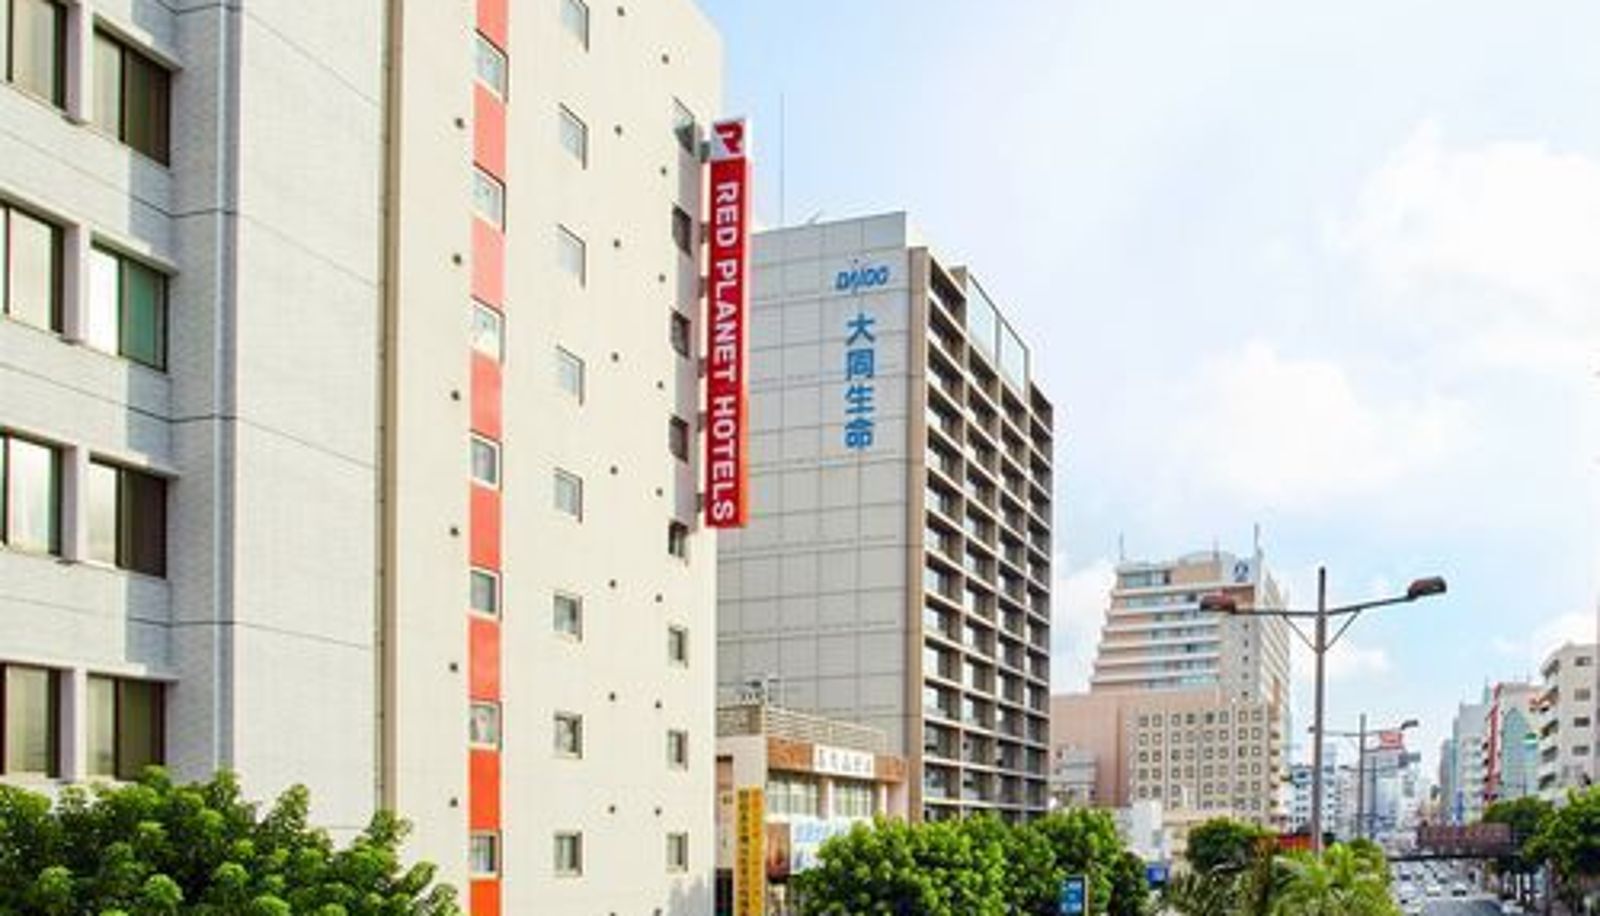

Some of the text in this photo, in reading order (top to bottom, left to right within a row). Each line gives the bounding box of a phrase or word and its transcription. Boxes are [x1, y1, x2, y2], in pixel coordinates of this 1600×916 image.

[711, 181, 739, 521] RED PLANET HOTELS
[845, 313, 876, 449] 大同生命
